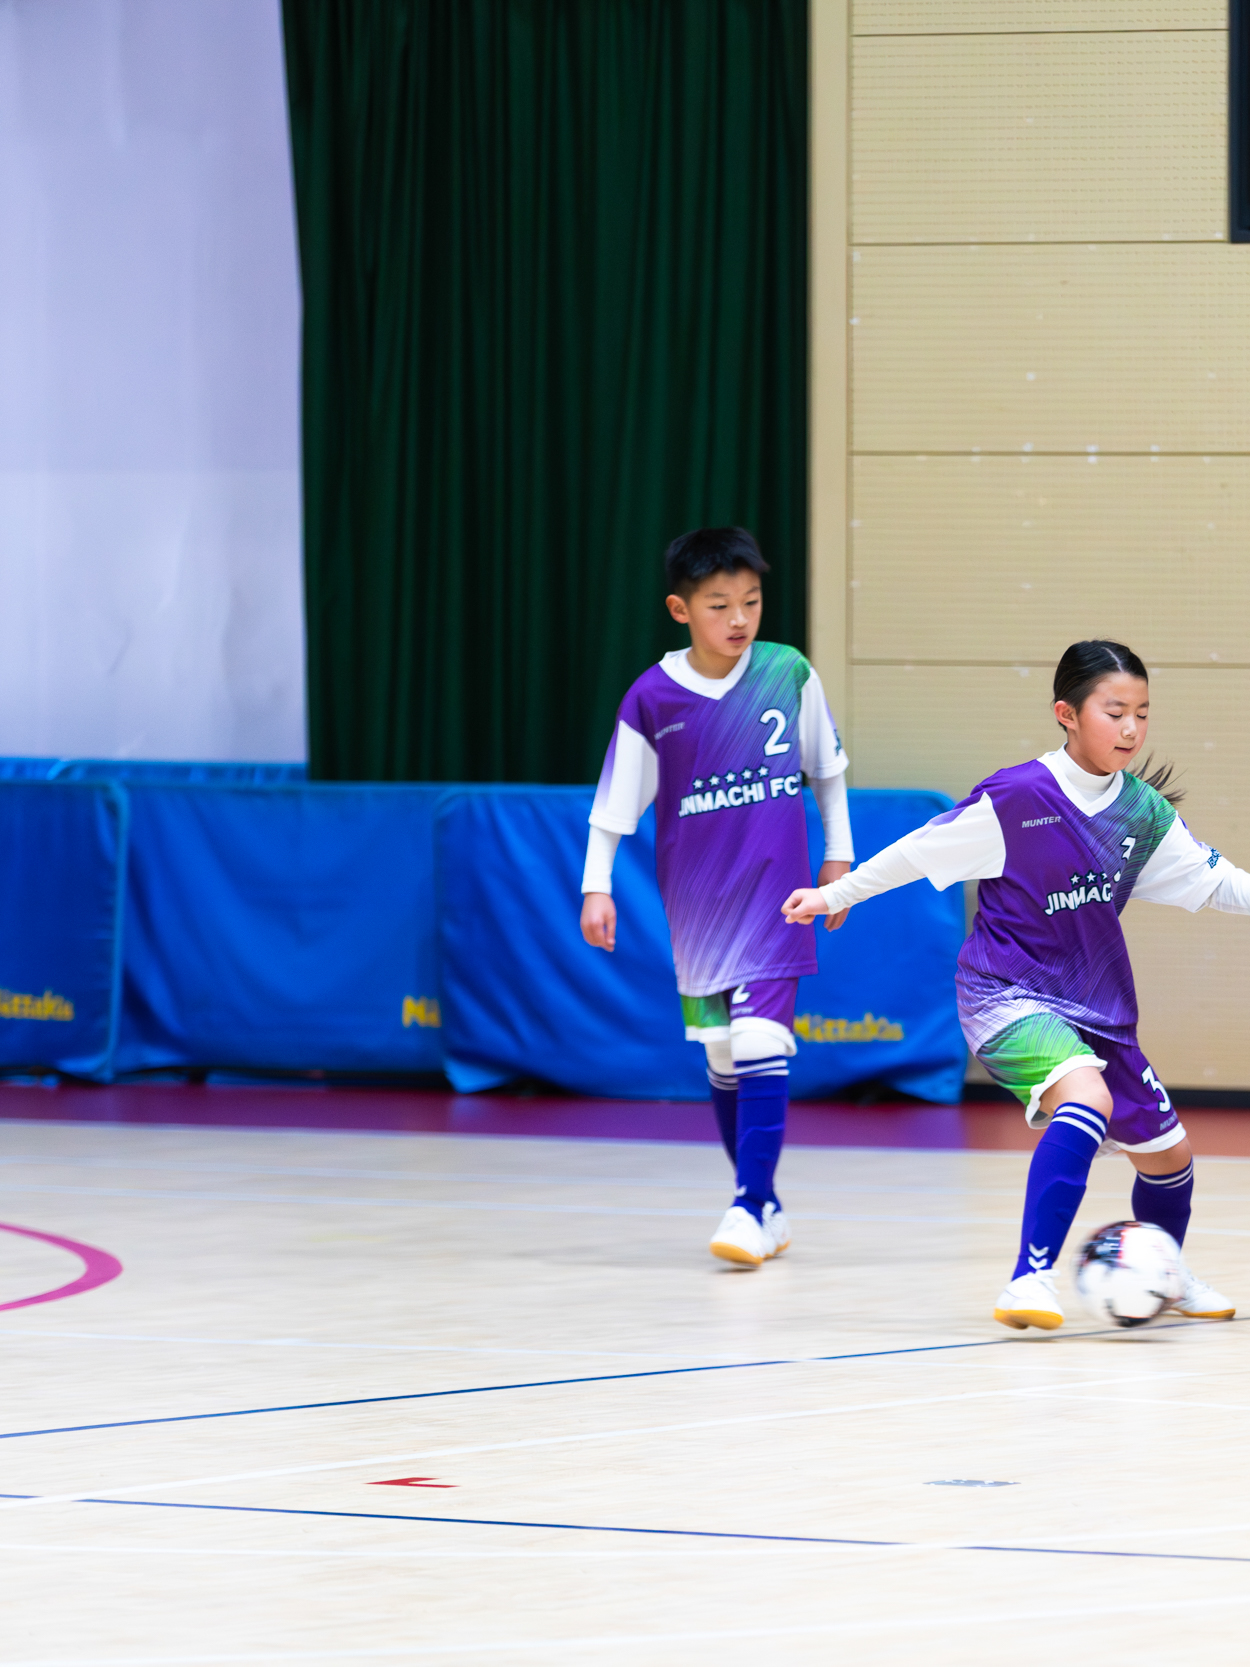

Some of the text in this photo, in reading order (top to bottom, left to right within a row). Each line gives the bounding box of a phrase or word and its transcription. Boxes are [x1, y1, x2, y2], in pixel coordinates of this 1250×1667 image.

[759, 708, 791, 757] 2
[769, 775, 800, 799] FC
[1021, 815, 1062, 829] MUNTER
[1043, 882, 1113, 916] JINMAC
[1141, 1065, 1172, 1113] 3
